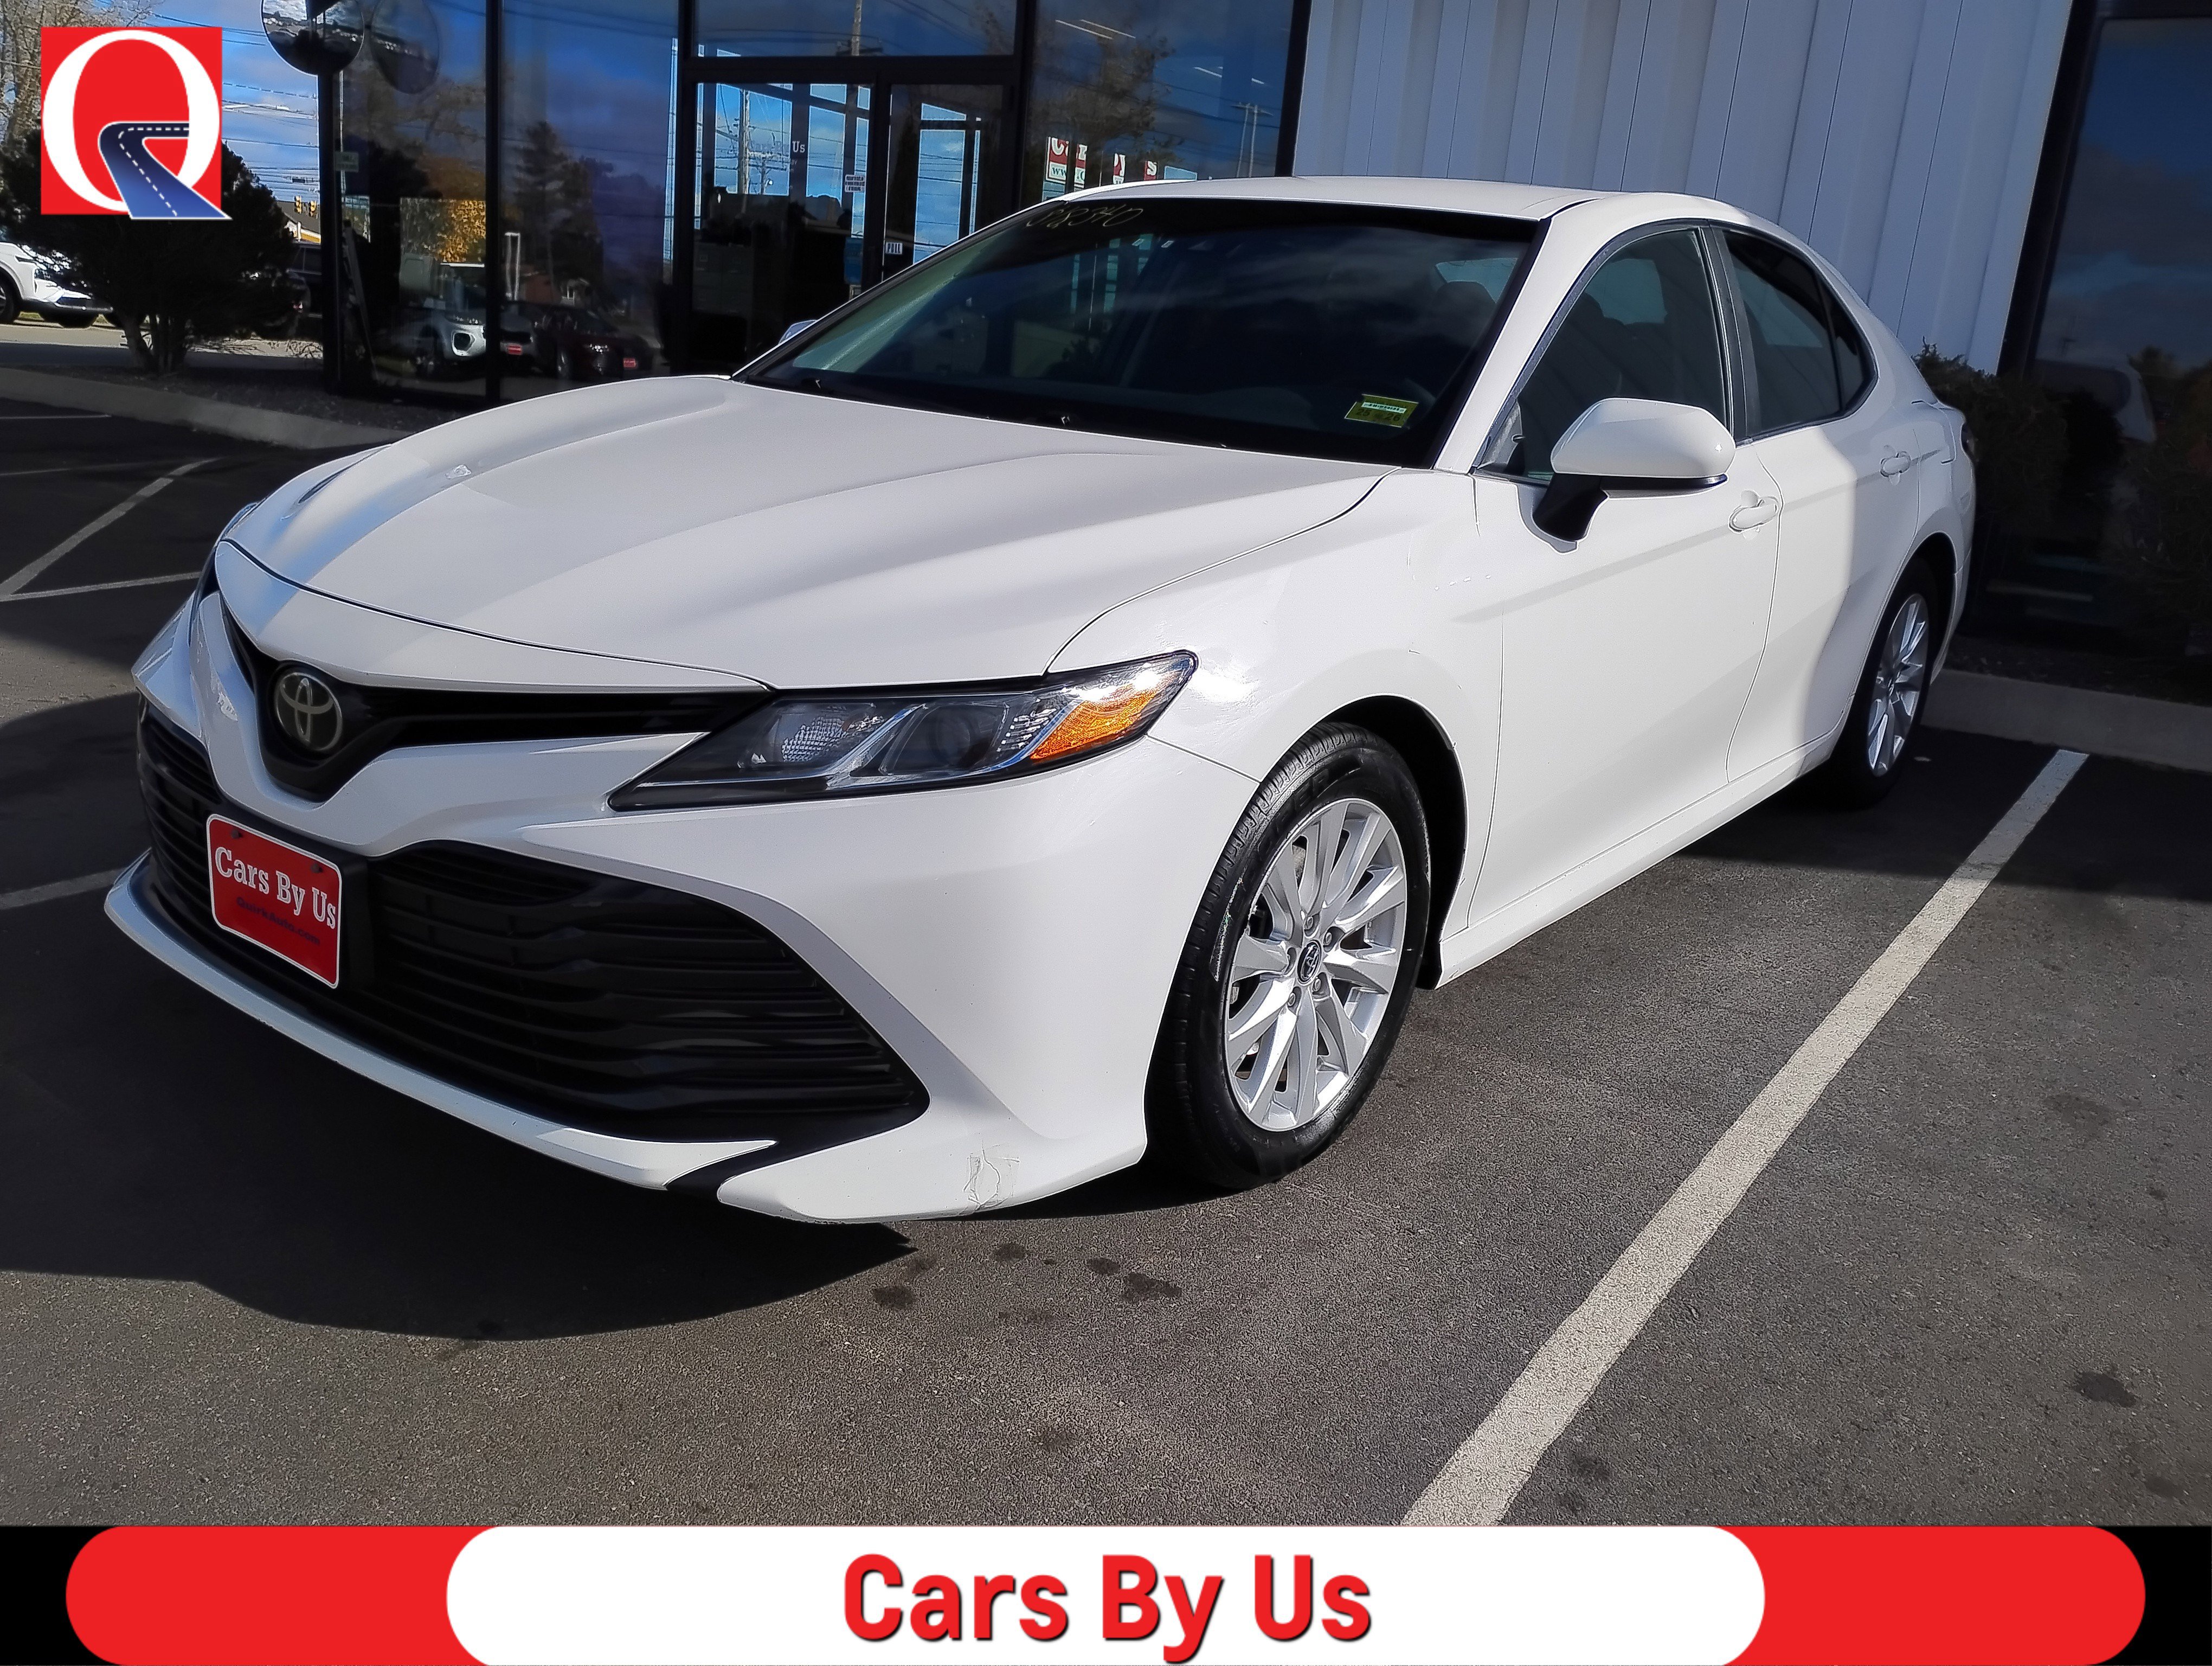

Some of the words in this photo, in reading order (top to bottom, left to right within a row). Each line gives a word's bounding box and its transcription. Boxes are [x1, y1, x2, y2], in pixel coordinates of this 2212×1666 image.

[792, 140, 805, 153] Us
[887, 242, 901, 254] PULL
[215, 846, 269, 895] Cars
[275, 870, 305, 917] By
[312, 887, 336, 930] Us
[236, 896, 320, 946] QuirkAuto.com
